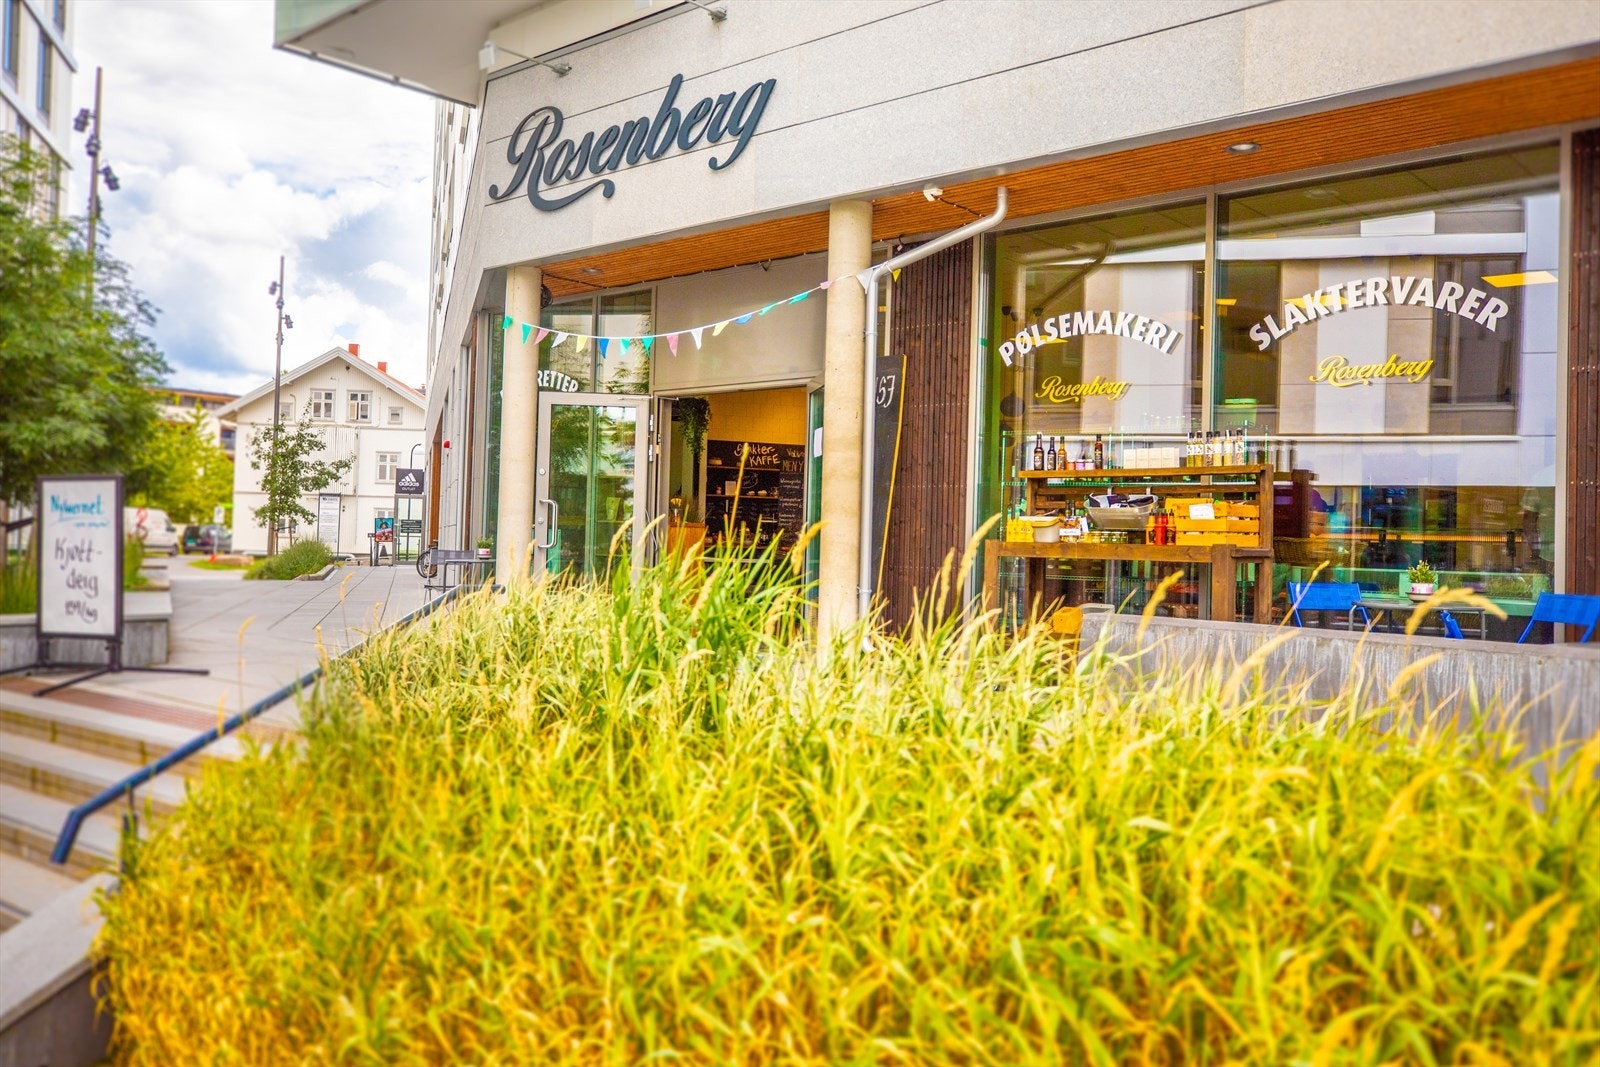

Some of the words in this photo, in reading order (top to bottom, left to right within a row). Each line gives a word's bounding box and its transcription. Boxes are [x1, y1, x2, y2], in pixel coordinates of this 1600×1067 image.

[489, 73, 777, 212] Rosenberg
[1249, 275, 1510, 352] SLAKTERVARER
[998, 310, 1180, 367] PØLSEMAKERI
[1034, 375, 1128, 403] Rosenberg
[1309, 353, 1434, 387] Rosenberg
[748, 453, 781, 467] KAFFE
